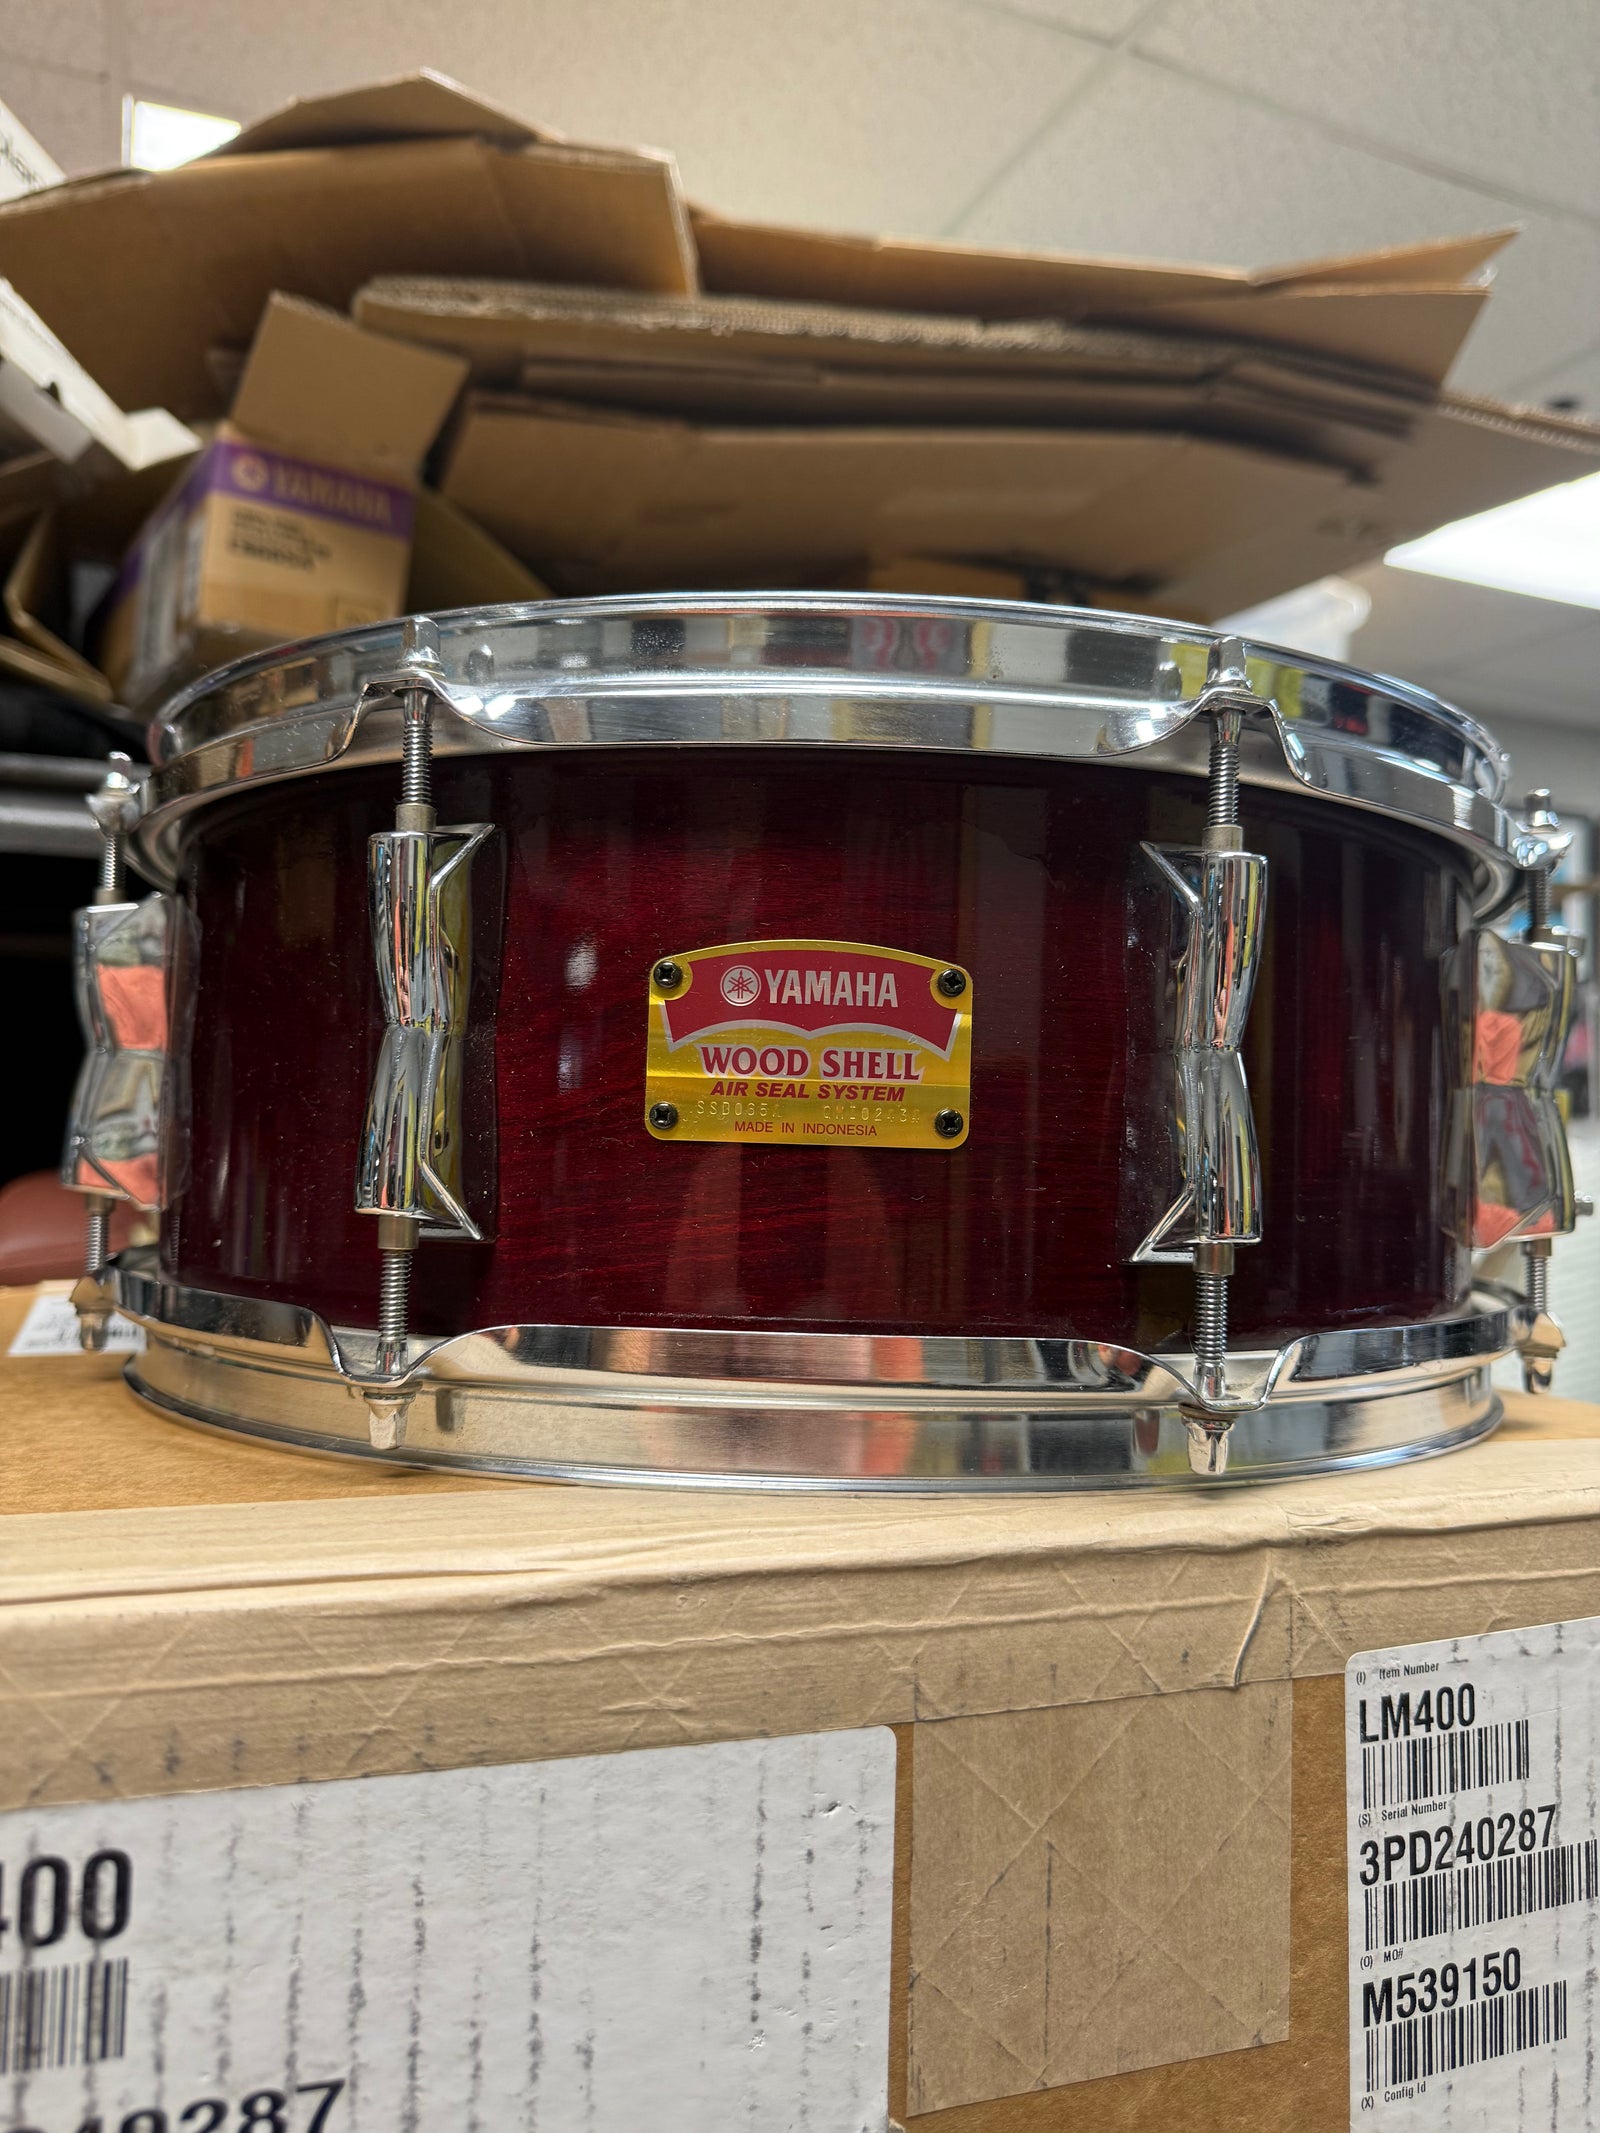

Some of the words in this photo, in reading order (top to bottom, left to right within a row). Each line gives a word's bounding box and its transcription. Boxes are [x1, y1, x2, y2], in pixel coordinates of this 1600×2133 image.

[765, 969, 898, 1008] YAMAHA
[701, 1047, 809, 1076] WOOD
[822, 1050, 920, 1080] SHELL
[710, 1081, 748, 1097] AIR
[755, 1082, 810, 1099] SEAL
[817, 1084, 905, 1102] SYSTEM
[734, 1121, 773, 1133] MADE
[781, 1122, 795, 1133] IN
[802, 1123, 877, 1136] INDONESIA
[1379, 1668, 1400, 1680] Item
[1403, 1662, 1440, 1676] Number
[1359, 1682, 1475, 1744] LM400
[1358, 1813, 1371, 1828] (S)
[1381, 1808, 1408, 1821] Serial
[1411, 1801, 1448, 1815] Number
[1359, 1804, 1556, 1886] 3PD240287
[0, 1848, 132, 1948] 00
[1362, 1947, 1521, 2028] M539150
[1361, 2096, 1374, 2110] (X)
[1384, 2086, 1414, 2102] Config
